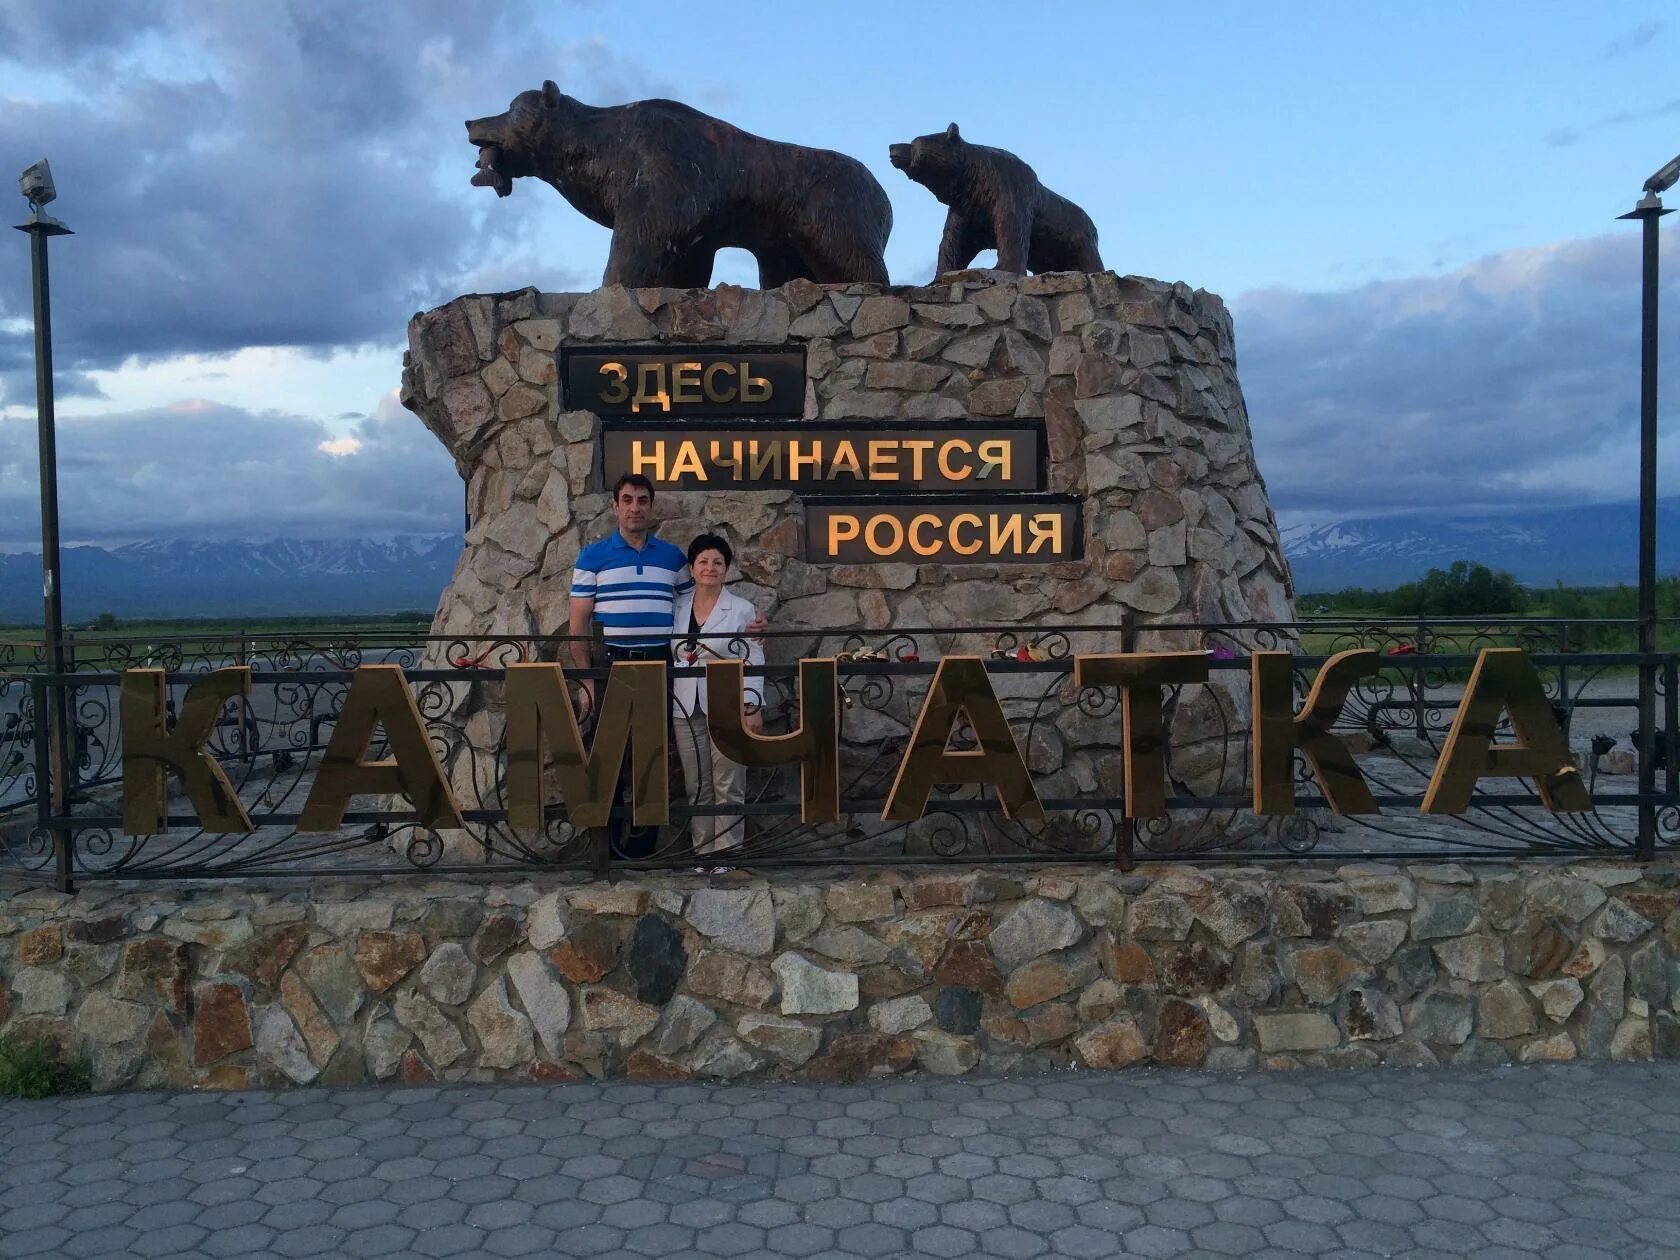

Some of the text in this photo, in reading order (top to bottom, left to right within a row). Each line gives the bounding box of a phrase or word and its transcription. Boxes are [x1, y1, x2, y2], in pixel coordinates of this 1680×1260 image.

[599, 362, 773, 412] ЗДЕСЬ
[631, 439, 1012, 481] НАЧИНАЕТСЯ
[828, 513, 1063, 556] РОССИЯ
[121, 647, 1594, 835] КАМЧАТКА
